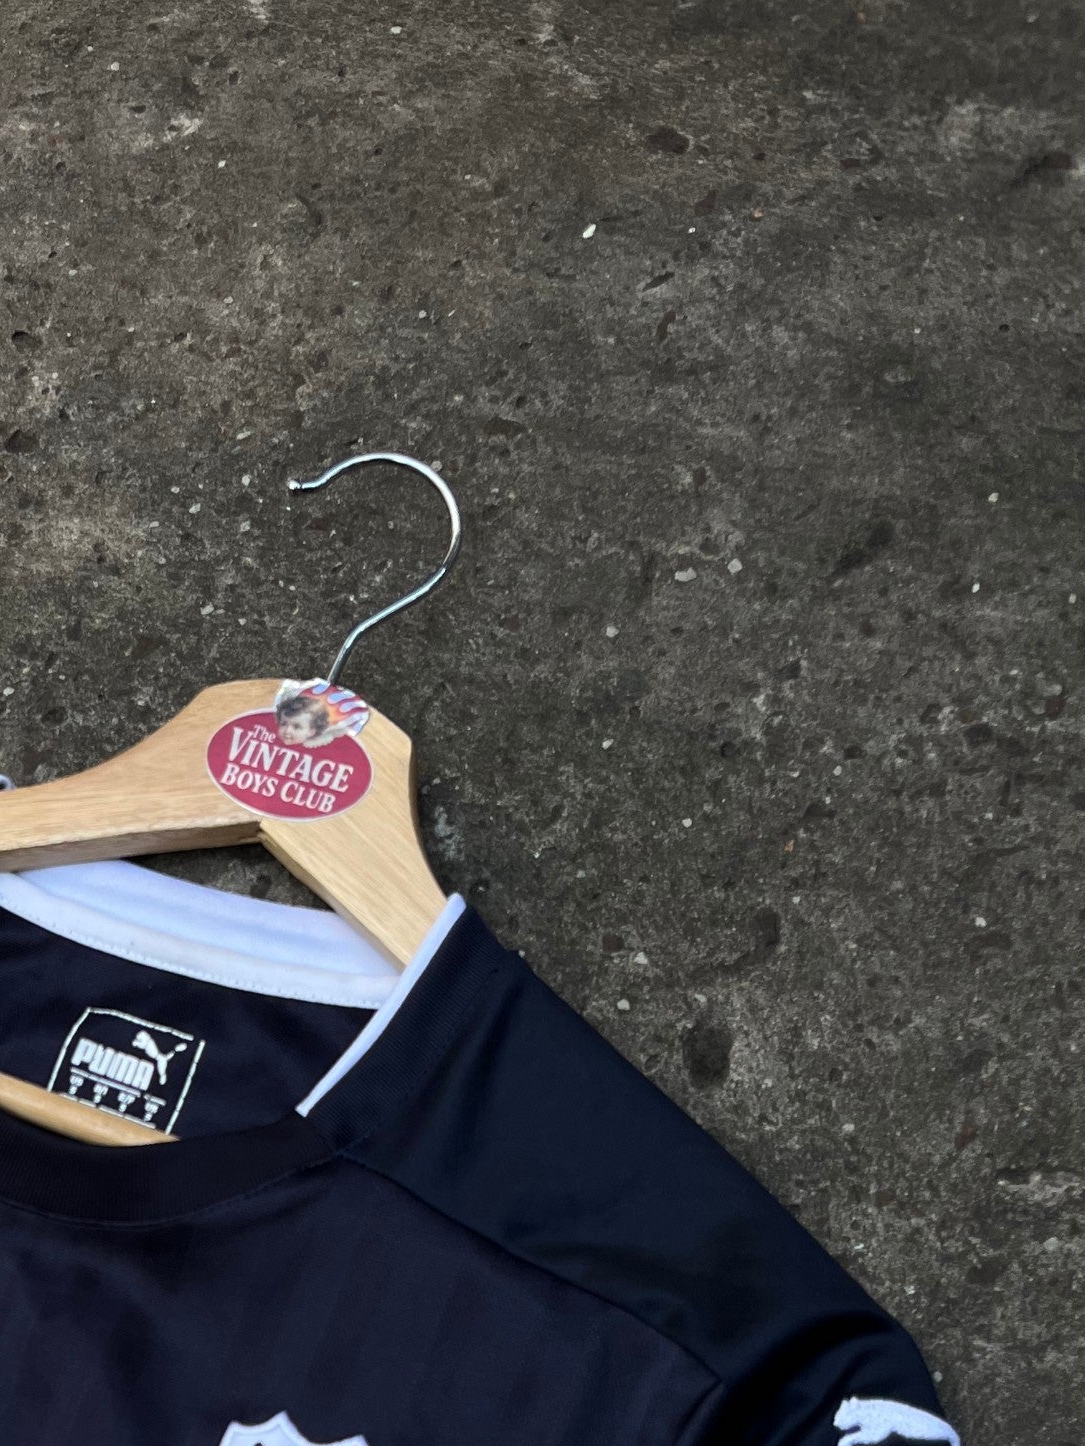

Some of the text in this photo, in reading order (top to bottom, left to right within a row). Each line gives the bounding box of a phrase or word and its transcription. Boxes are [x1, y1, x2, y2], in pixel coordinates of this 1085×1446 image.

[228, 725, 354, 794] VINTAGE
[253, 724, 277, 744] The
[220, 762, 337, 814] BOYS CLUB
